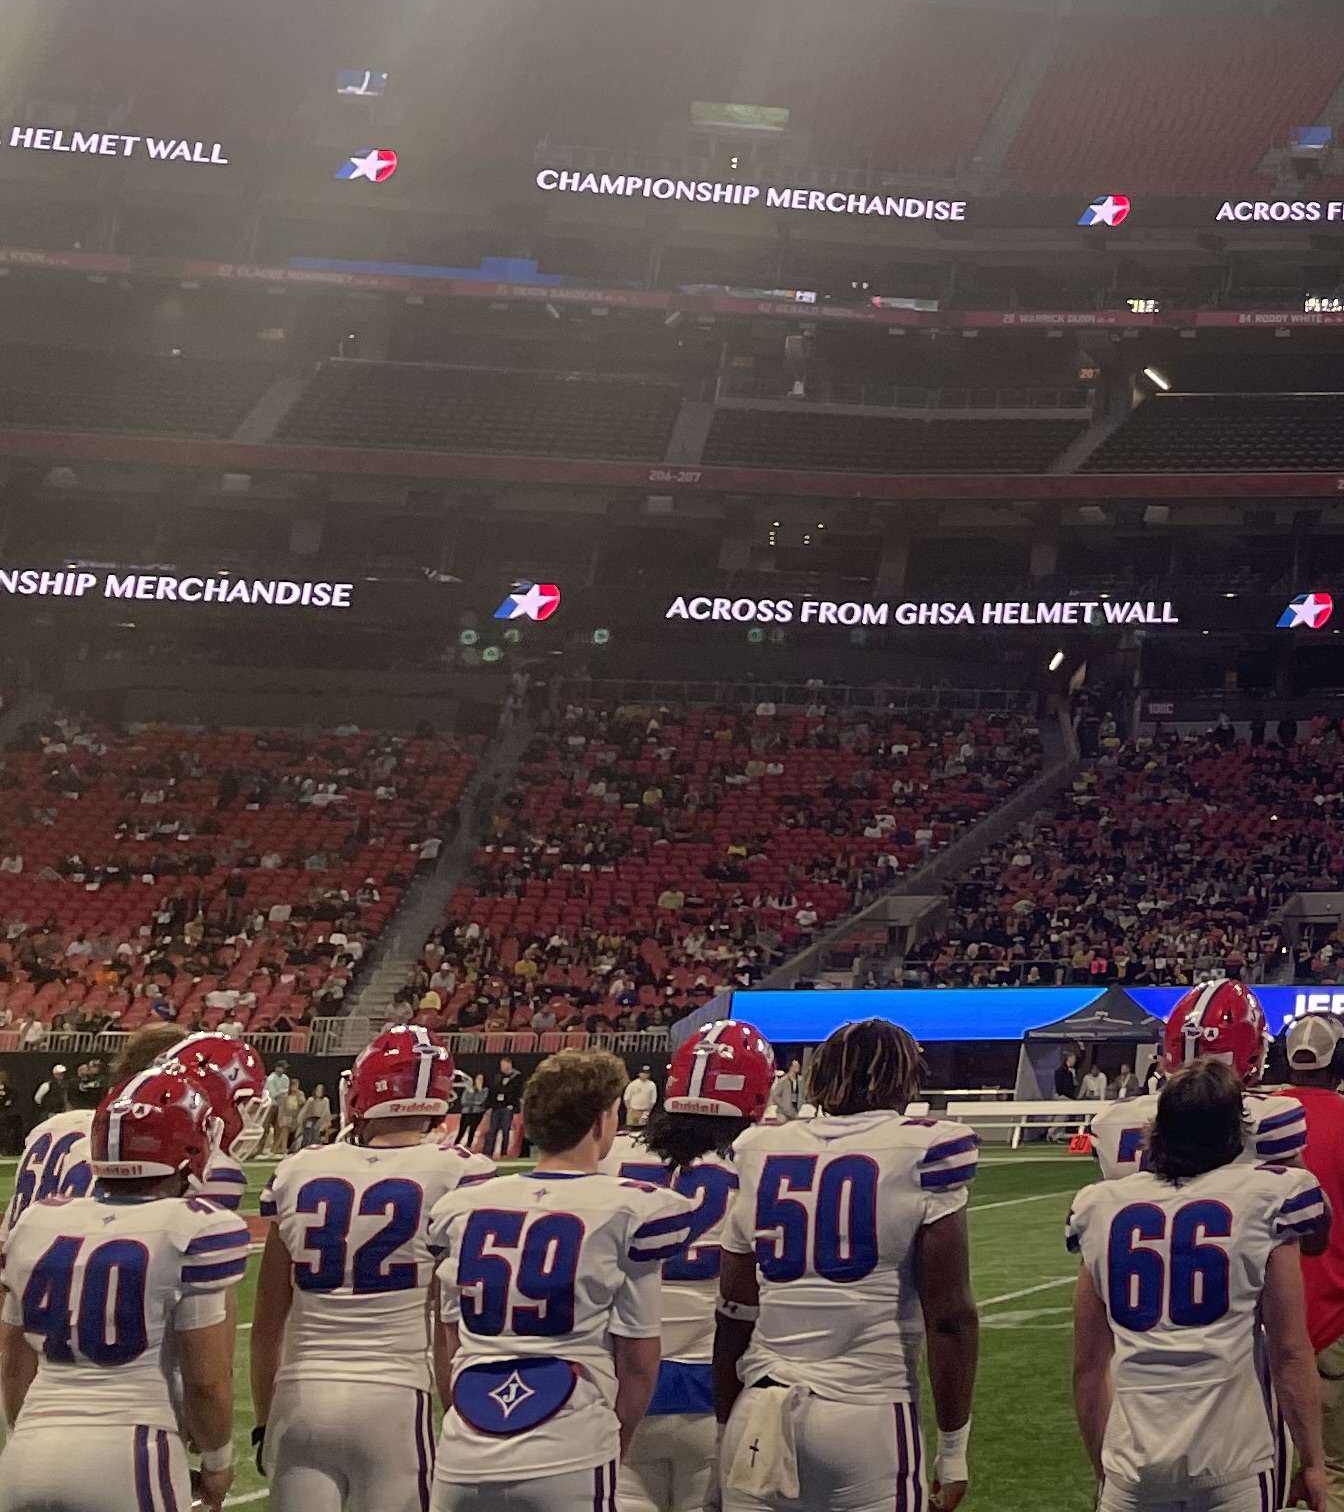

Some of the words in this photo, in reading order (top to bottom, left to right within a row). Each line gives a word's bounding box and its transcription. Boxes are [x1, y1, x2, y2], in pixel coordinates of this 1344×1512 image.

[10, 126, 141, 158] HELMET
[146, 138, 229, 165] WALL
[536, 169, 760, 206] CHAMPIONSHIP
[767, 188, 967, 221] MERCHANDISE
[1216, 202, 1321, 222] ACROSS
[104, 573, 354, 607] MERCHANDISE
[666, 597, 794, 623] ACROSS
[801, 600, 889, 625] FROM
[896, 603, 975, 625] GHSA
[982, 602, 1097, 625] HELMET
[1104, 602, 1179, 624] WALL
[228, 1068, 238, 1081] J
[294, 1177, 425, 1295] 32
[619, 1163, 740, 1280] 2
[755, 1154, 879, 1283] 50
[458, 1208, 585, 1338] 59
[1107, 1199, 1233, 1332] 66
[21, 1235, 150, 1366] 40
[503, 1382, 519, 1402] J
